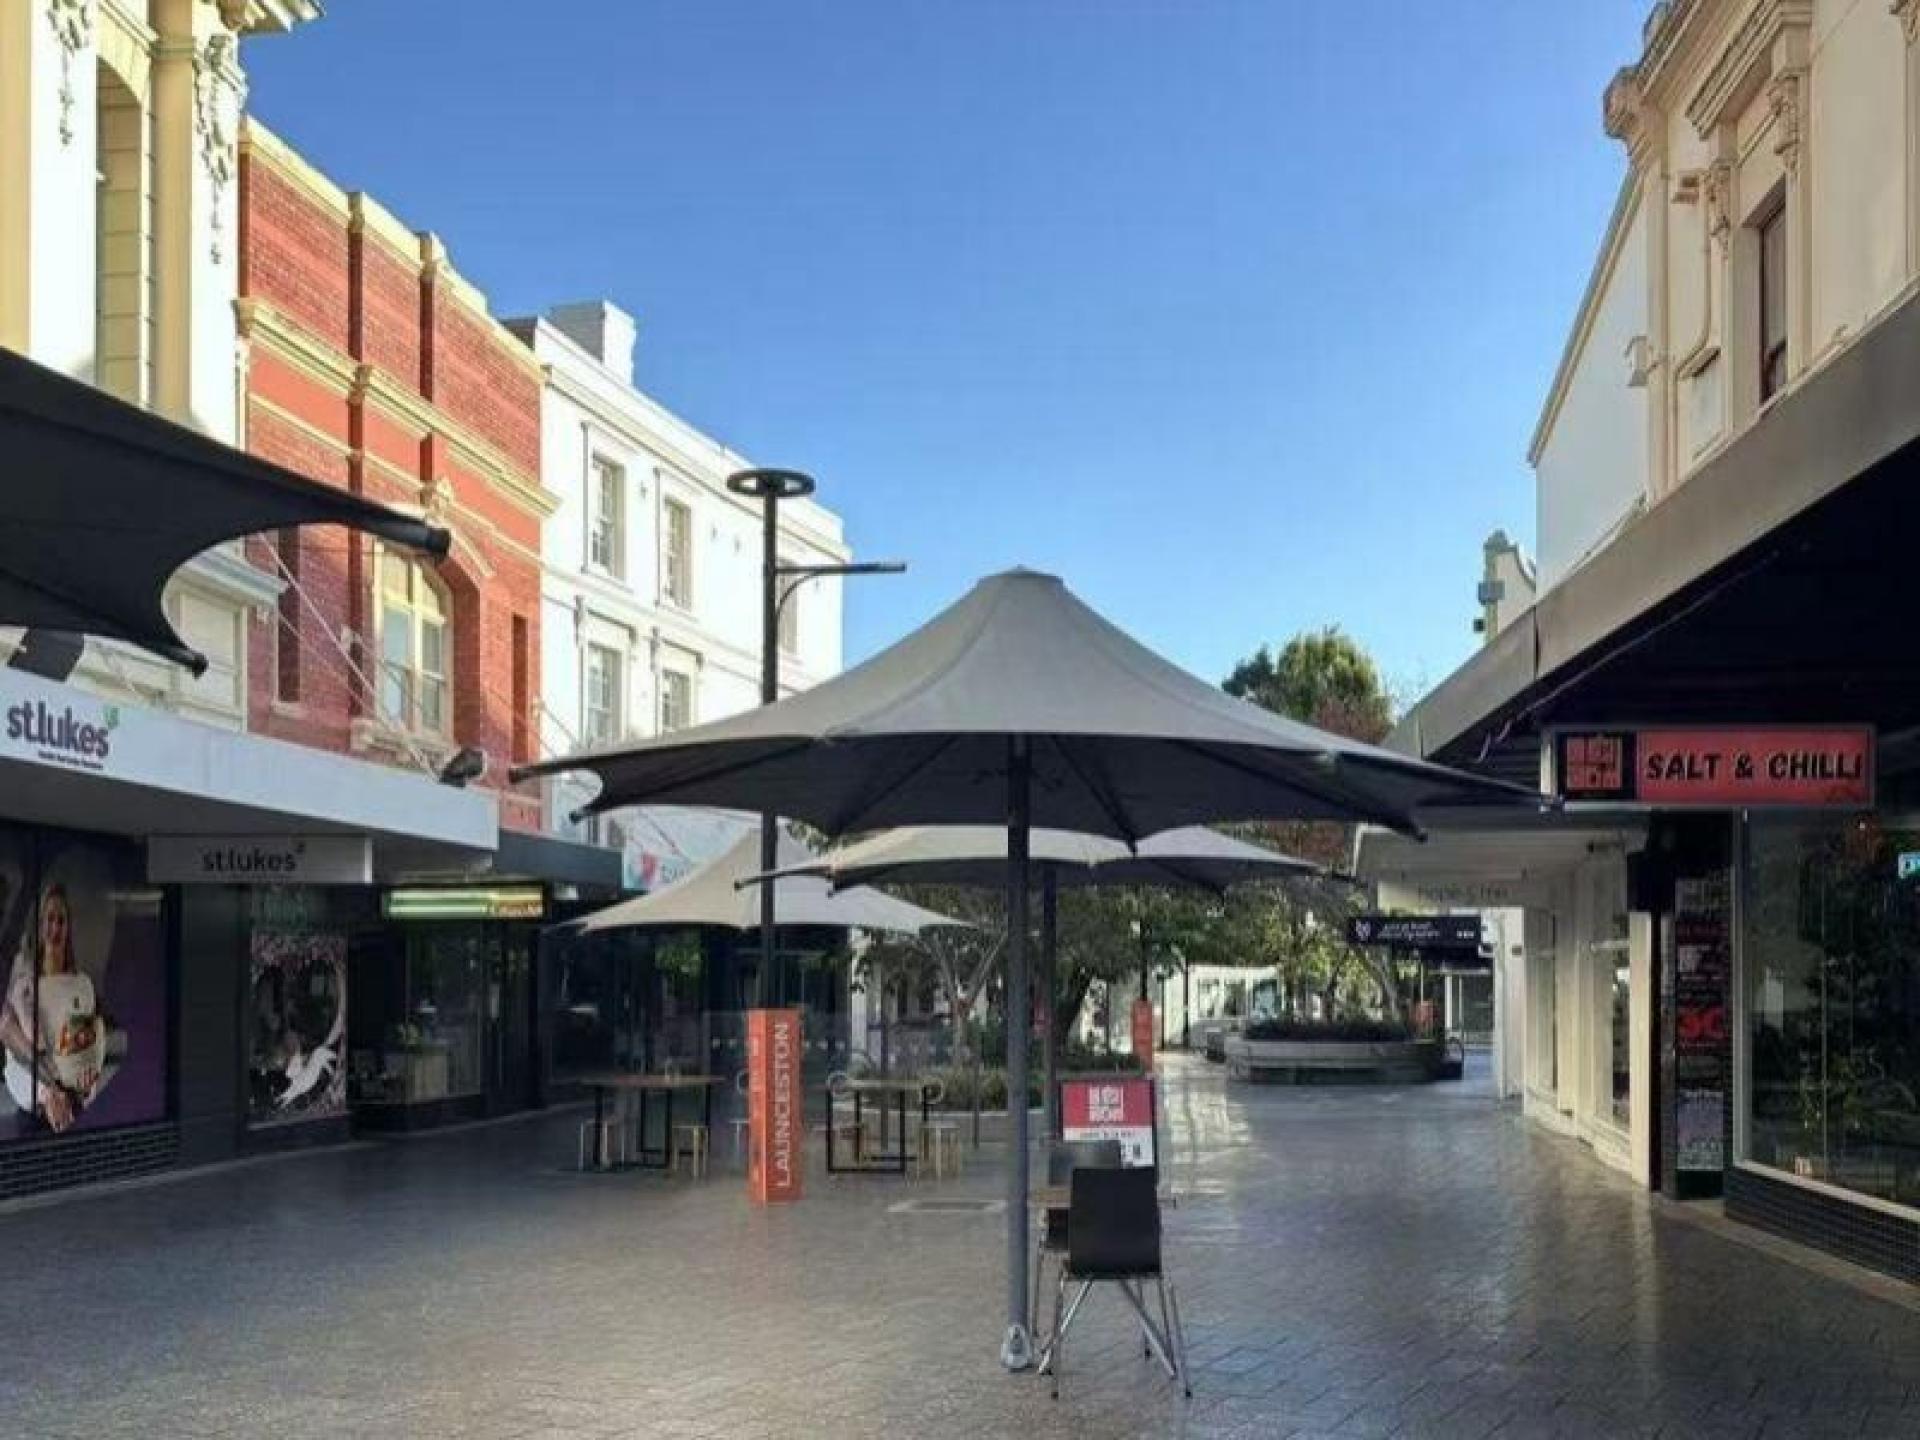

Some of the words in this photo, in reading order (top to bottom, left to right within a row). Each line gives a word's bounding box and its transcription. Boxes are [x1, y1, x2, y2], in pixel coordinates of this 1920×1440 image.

[1647, 752, 1721, 780] SALT
[1735, 752, 1754, 780] &
[1769, 752, 1862, 781] CHILLI
[774, 1024, 791, 1187] LAUNCESTON
